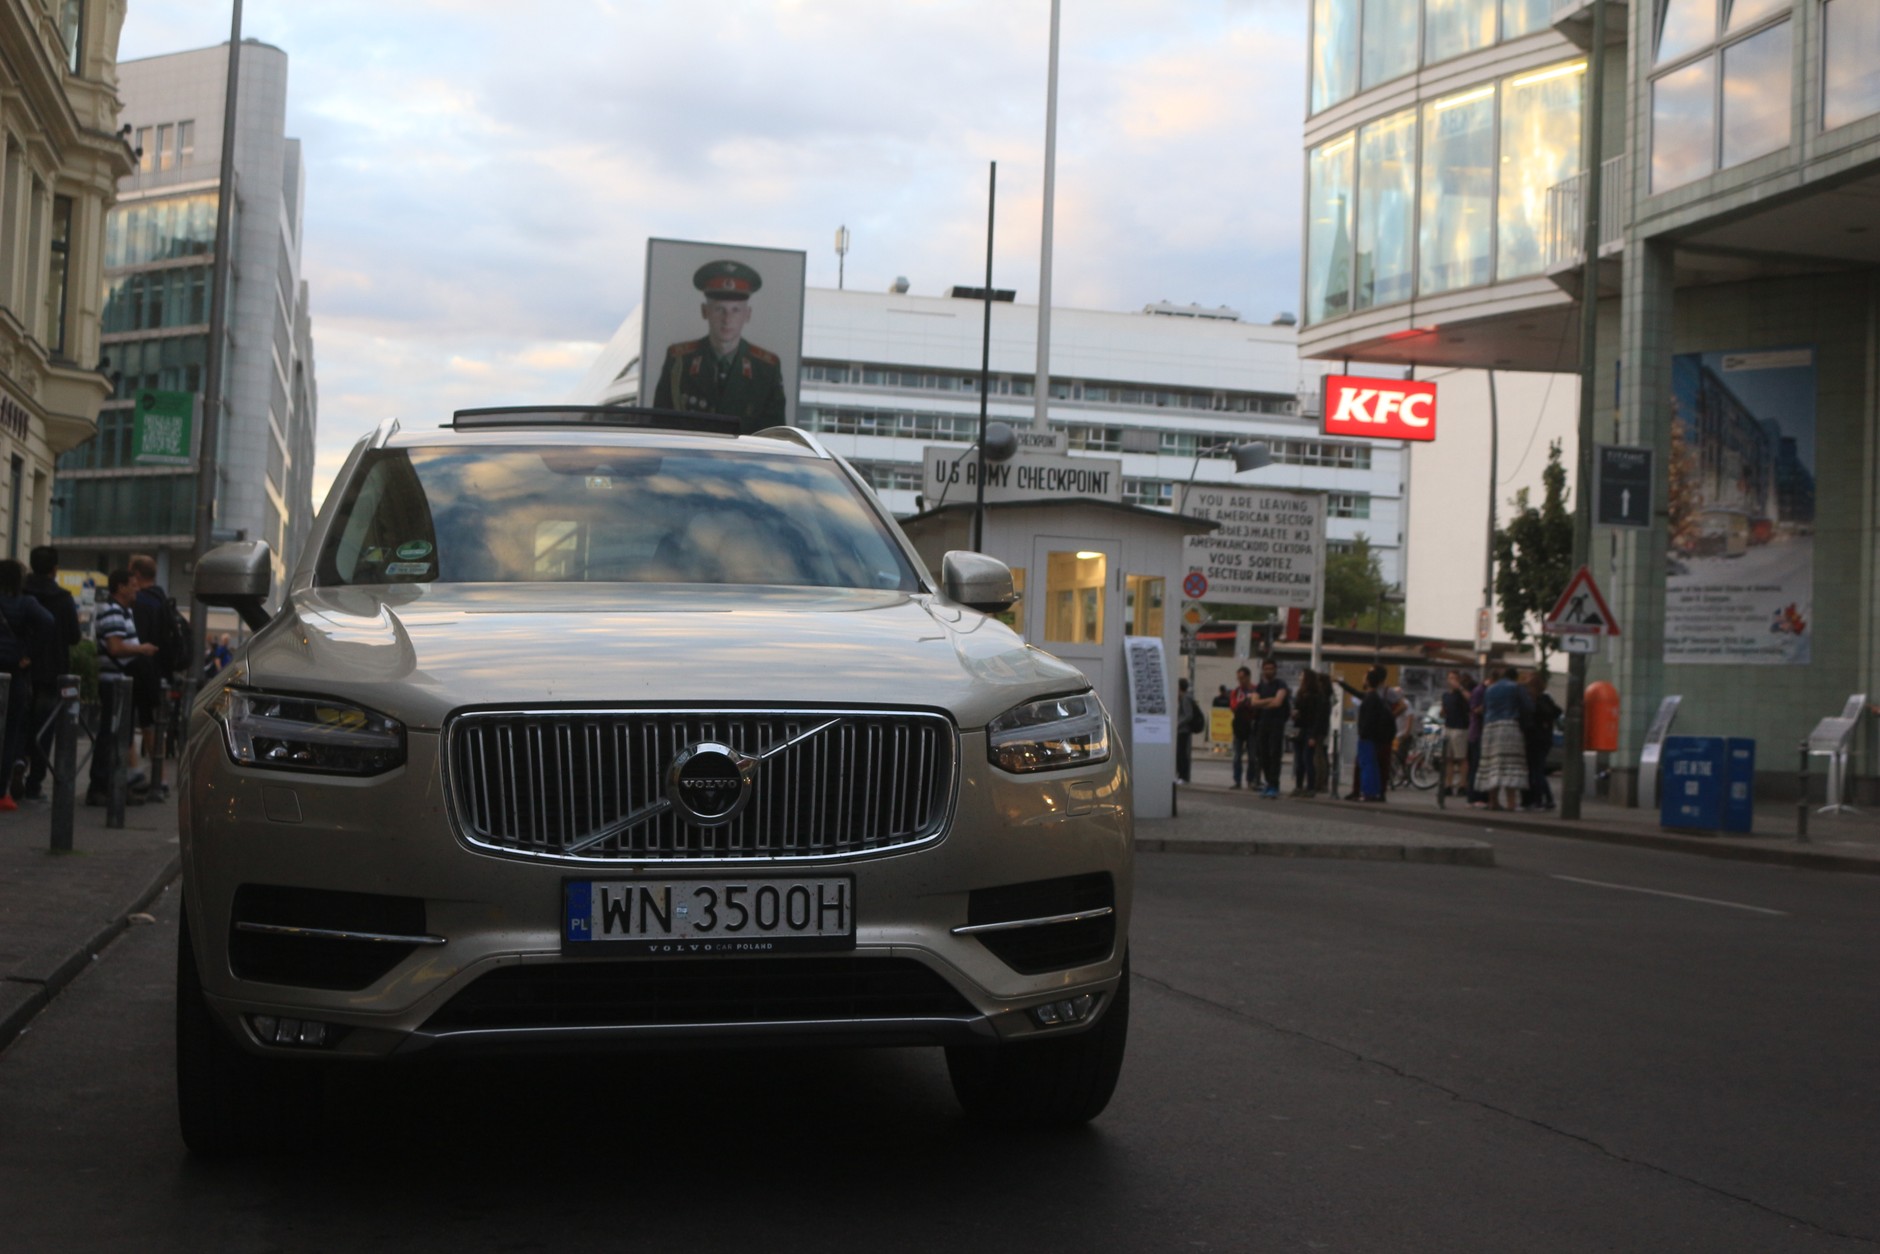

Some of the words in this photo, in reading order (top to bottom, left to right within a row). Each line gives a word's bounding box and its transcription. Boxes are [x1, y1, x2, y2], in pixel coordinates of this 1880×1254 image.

[1332, 388, 1433, 427] KFC
[1017, 465, 1111, 495] CHECKPOINT
[1199, 494, 1223, 506] YOU
[1230, 496, 1252, 509] ARE
[1259, 498, 1308, 513] LEAVING
[1192, 507, 1211, 520] THE
[1216, 509, 1270, 523] AMERICAN
[1275, 513, 1314, 526] SECTOR
[1209, 552, 1242, 566] VOUS
[1248, 555, 1292, 570] SORTEZ
[1207, 566, 1254, 580] SECTEUR
[1255, 570, 1311, 584] AMERICAIN
[681, 779, 737, 789] VOLVO
[600, 885, 672, 934] WN
[692, 883, 845, 934] 3500H
[571, 919, 589, 931] PL
[648, 944, 713, 952] VOLVO
